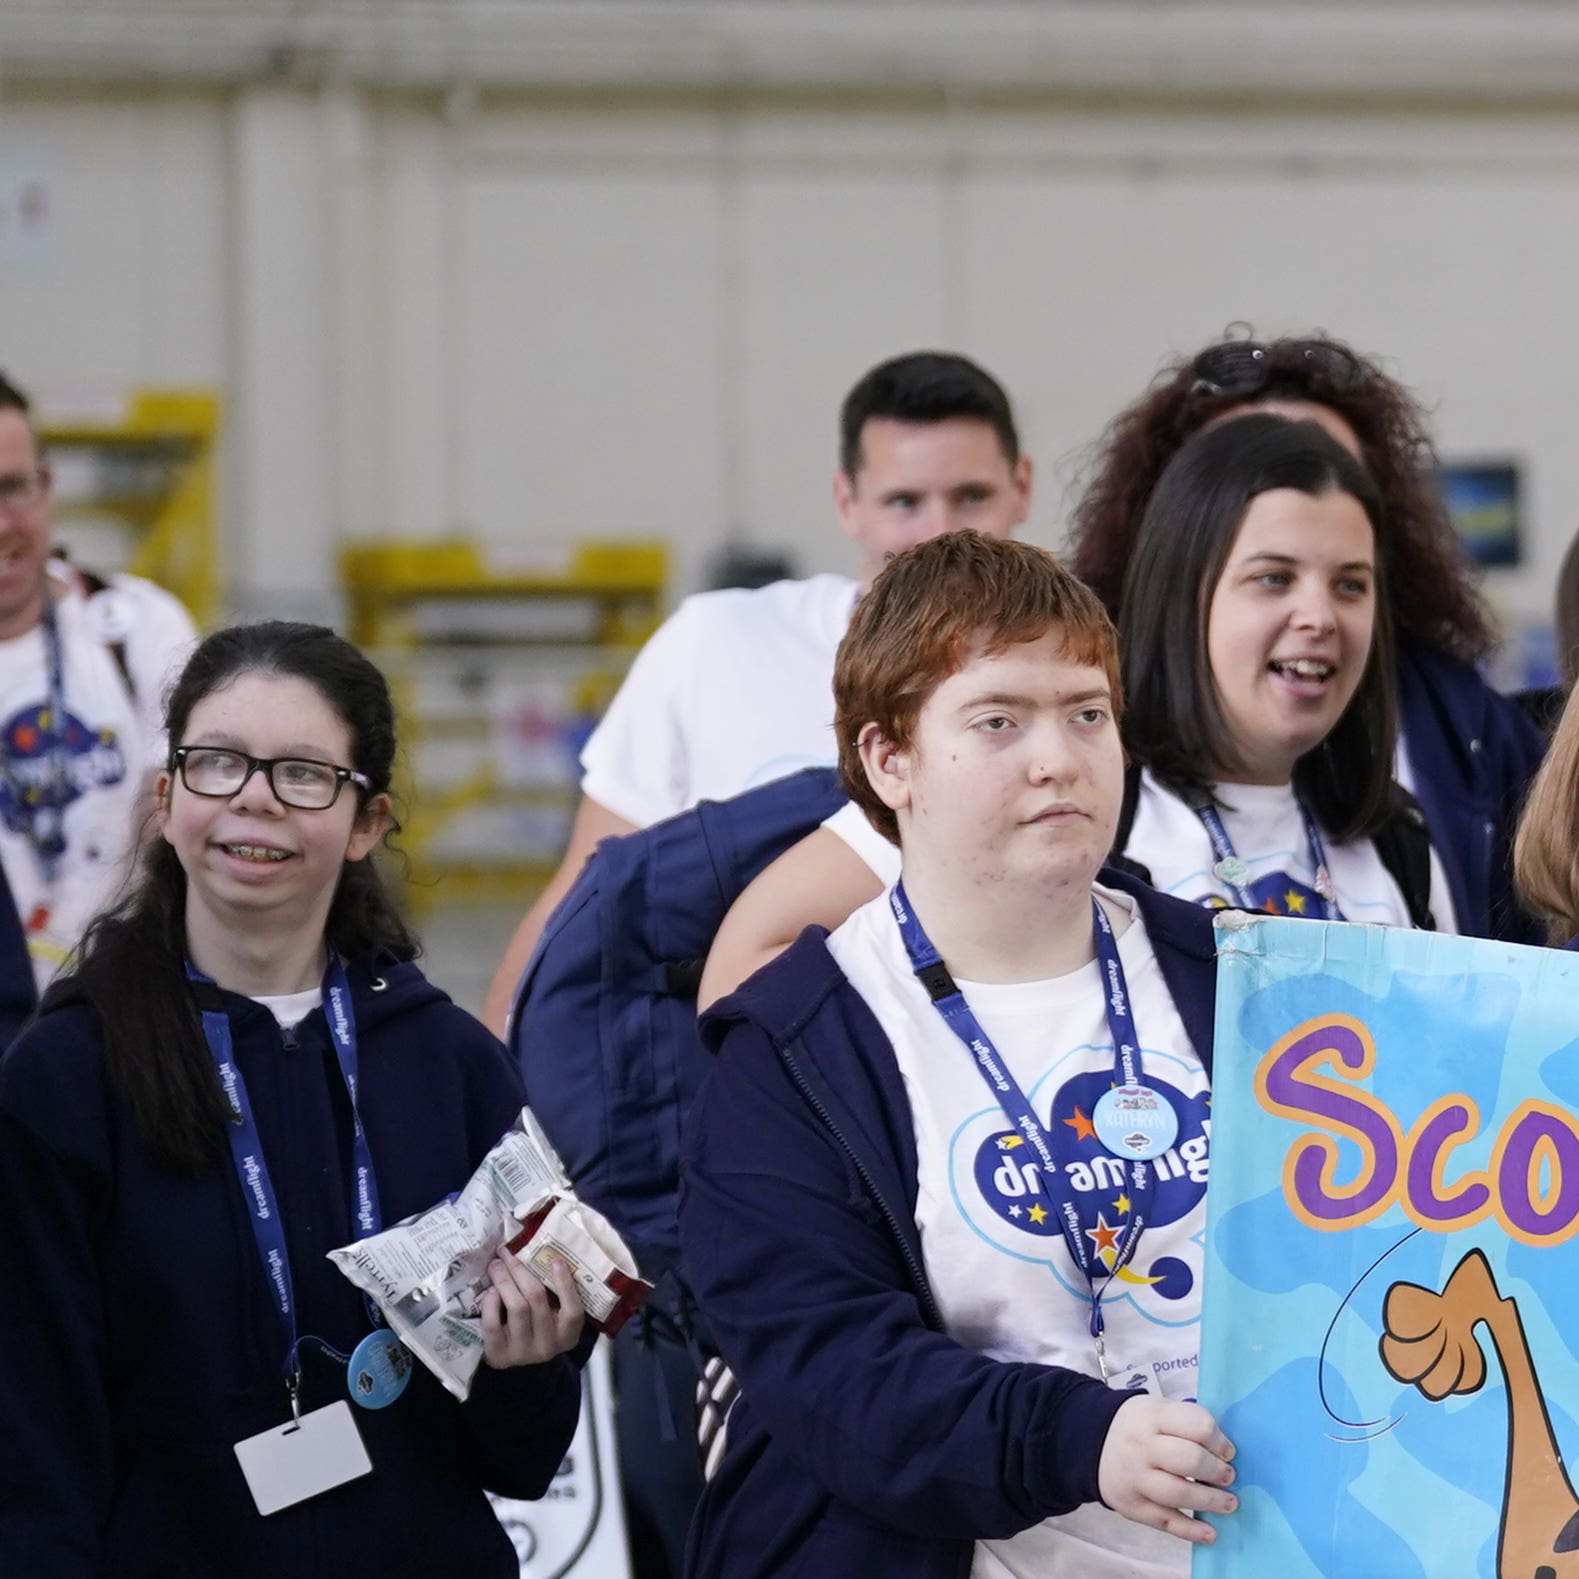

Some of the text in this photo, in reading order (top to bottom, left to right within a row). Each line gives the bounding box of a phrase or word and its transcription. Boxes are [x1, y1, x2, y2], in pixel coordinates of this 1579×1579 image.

[328, 985, 351, 1046] dreamflight
[1107, 958, 1126, 1016] dreamflight
[218, 1062, 244, 1126] eamflight
[970, 1038, 1010, 1093] dreamflight
[1120, 1044, 1139, 1086] dreamfl
[1019, 1114, 1056, 1175] dreamflight
[243, 1155, 271, 1220] dreamflight
[357, 1166, 374, 1231] dreamflight
[268, 1248, 289, 1314] dreamflight
